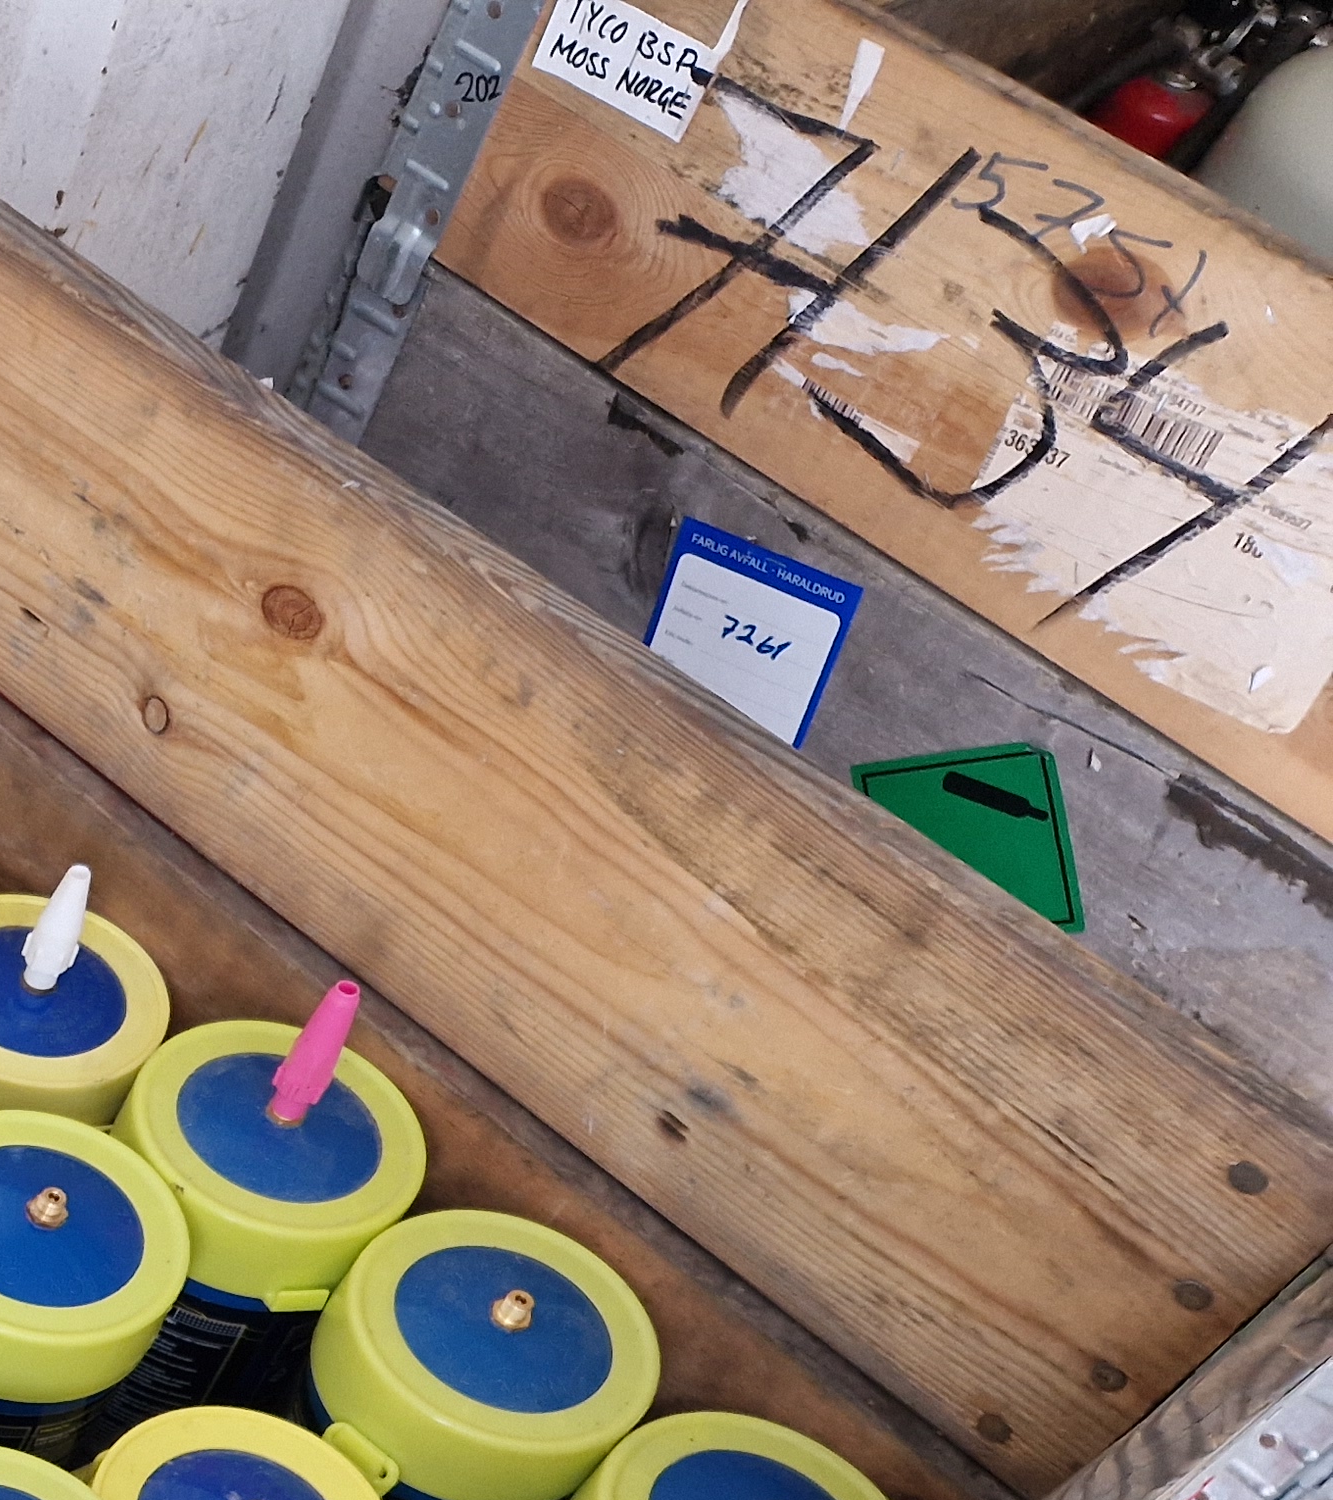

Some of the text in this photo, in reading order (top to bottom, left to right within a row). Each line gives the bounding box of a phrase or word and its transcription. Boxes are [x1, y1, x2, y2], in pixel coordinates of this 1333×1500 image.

[549, 32, 692, 119] MOSS NORGE
[690, 531, 730, 558] FARLIG
[729, 549, 769, 574] AVFALL
[776, 567, 846, 605] HARALDRUD
